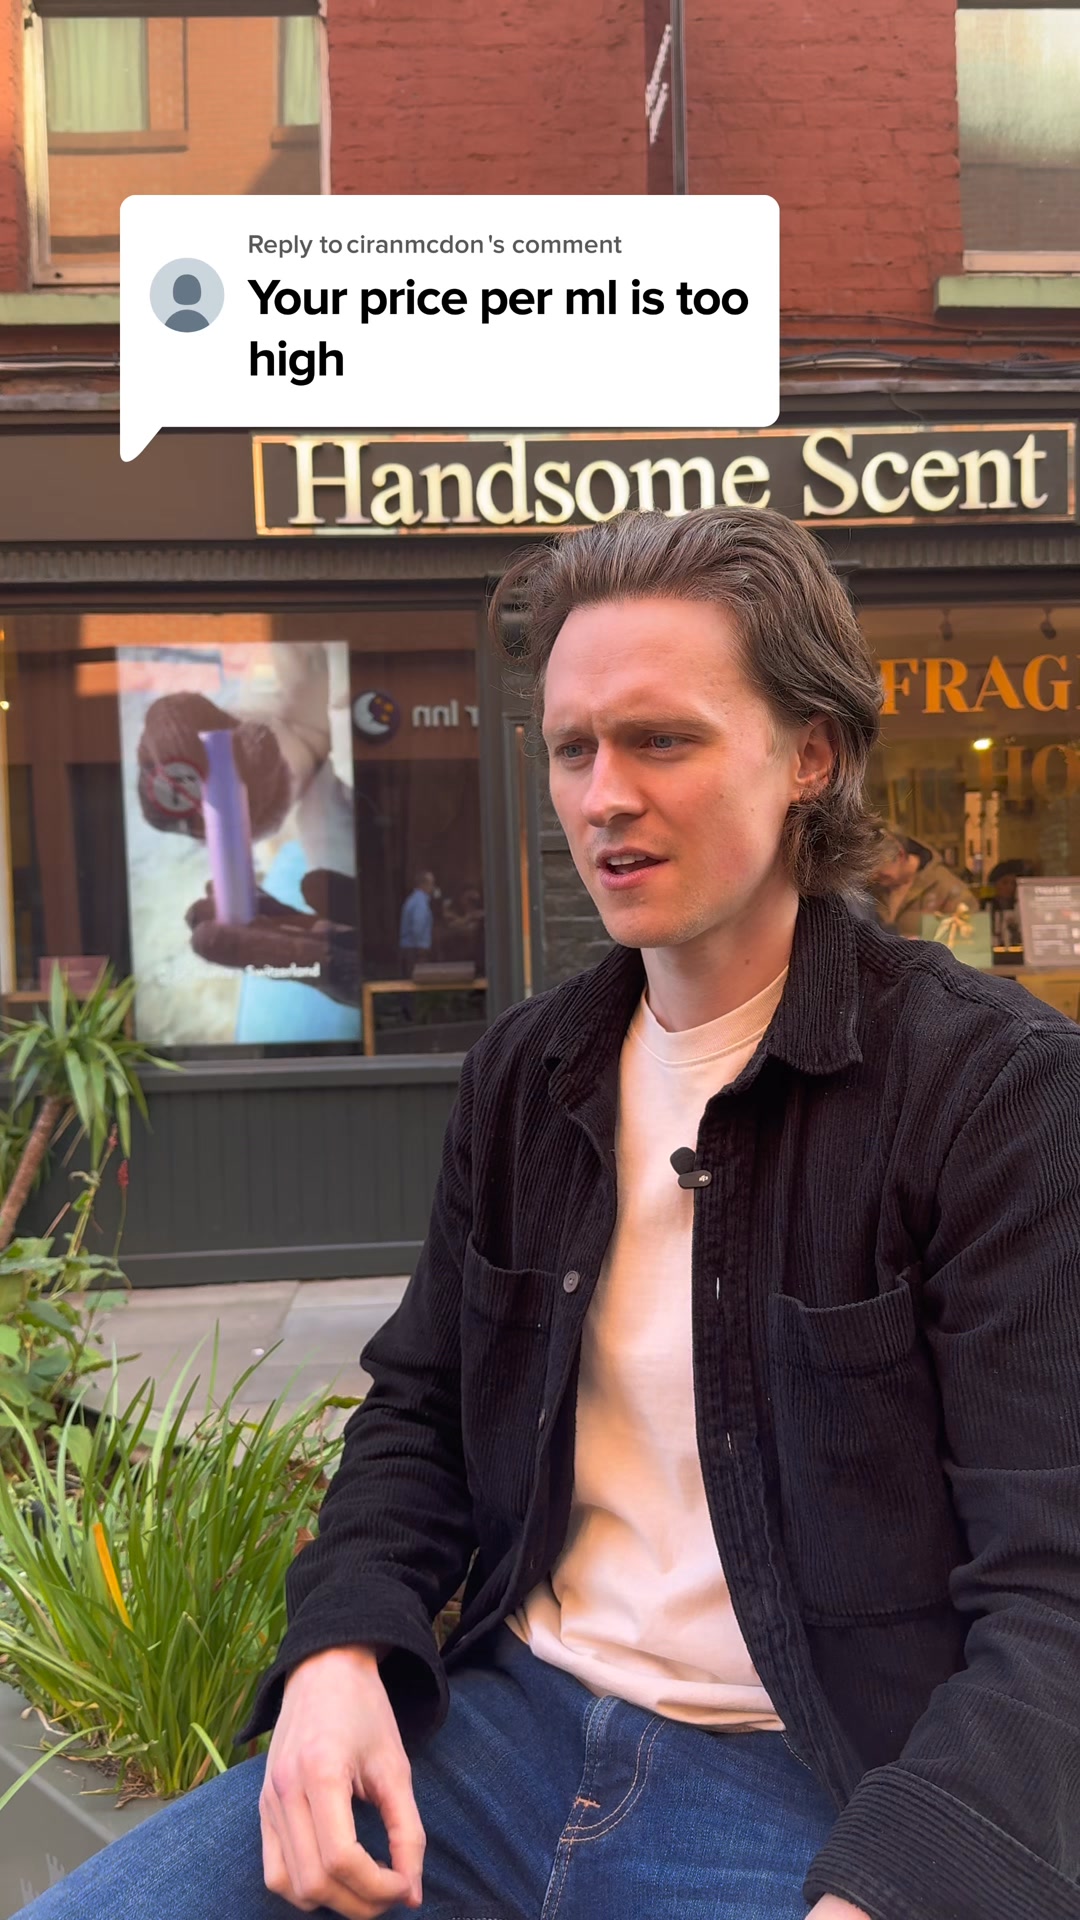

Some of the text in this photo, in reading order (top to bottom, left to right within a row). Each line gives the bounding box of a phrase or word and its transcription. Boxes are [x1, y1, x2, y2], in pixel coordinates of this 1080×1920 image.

[287, 428, 1048, 526] Handsome Scent
[878, 654, 1080, 716] FRAG
